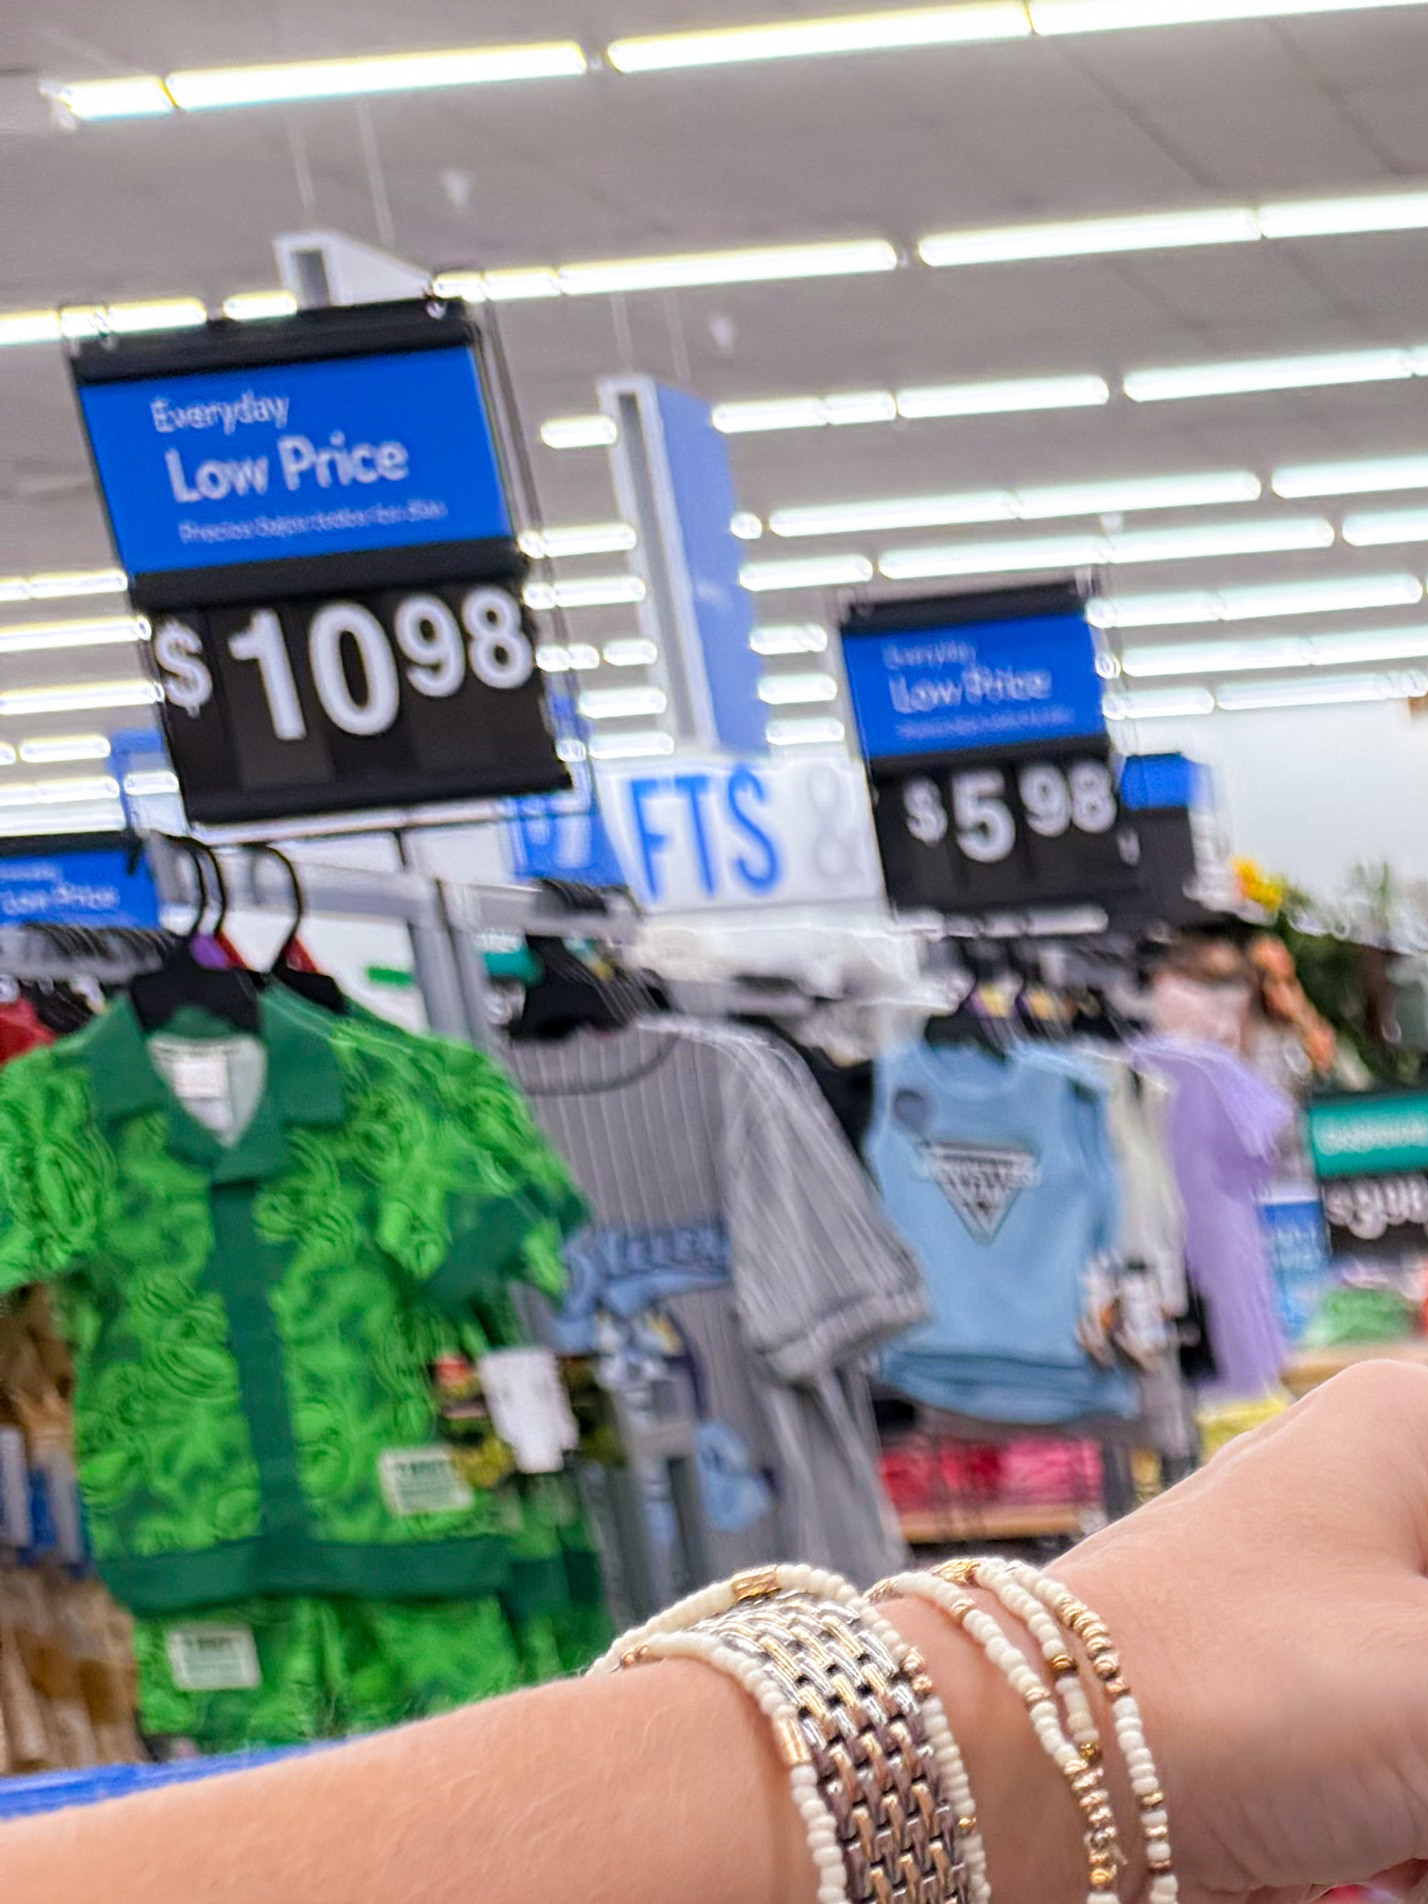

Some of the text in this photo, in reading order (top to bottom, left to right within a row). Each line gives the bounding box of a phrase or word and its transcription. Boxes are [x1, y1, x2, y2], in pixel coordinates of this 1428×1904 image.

[151, 391, 289, 435] Everyday
[165, 431, 409, 503] Low Price
